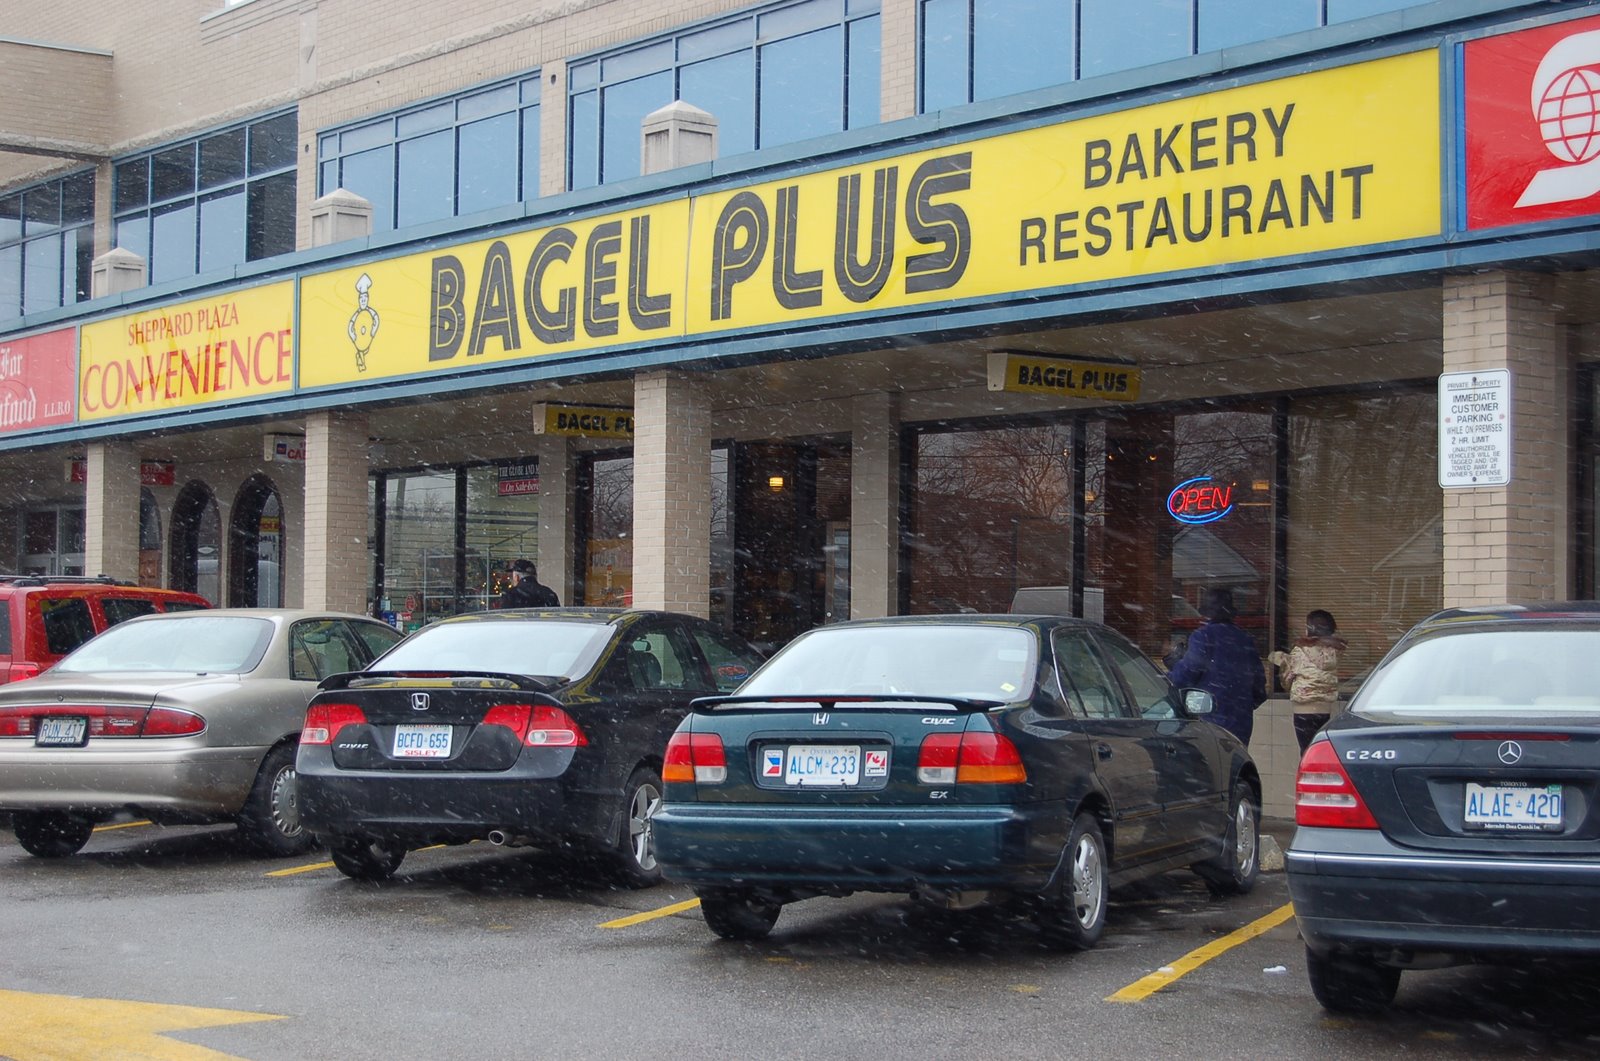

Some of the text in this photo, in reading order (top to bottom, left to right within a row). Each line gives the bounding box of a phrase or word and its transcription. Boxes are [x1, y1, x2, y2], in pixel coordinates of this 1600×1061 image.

[1084, 102, 1295, 190] BAKERY
[1019, 164, 1373, 266] RESTAURANT
[429, 151, 972, 362] BAGEL PLUS
[129, 302, 239, 346] SHEPPARD PLAZA
[83, 329, 292, 413] CONVENIENCE
[1018, 365, 1127, 392] BAGEL PLUS
[1453, 392, 1496, 403] IMMEDIATE
[1451, 402, 1499, 414] CUSTOMER
[557, 413, 610, 431] BAGEL
[1457, 413, 1493, 423] PARKING
[1447, 424, 1503, 435] WHILE ON PREMISES
[1451, 436, 1456, 445] 2
[1472, 435, 1489, 443] LIMIT
[1452, 445, 1496, 453] UNAUTHORIZED
[1475, 469, 1501, 477] EXPENSE
[1169, 486, 1231, 513] OPEN
[921, 717, 956, 725] CIVIC
[429, 733, 448, 748] 655
[1346, 750, 1396, 760] C 240
[790, 756, 856, 774] ALCM 233
[929, 791, 948, 799] EX
[1468, 792, 1560, 818] ALAE 420
